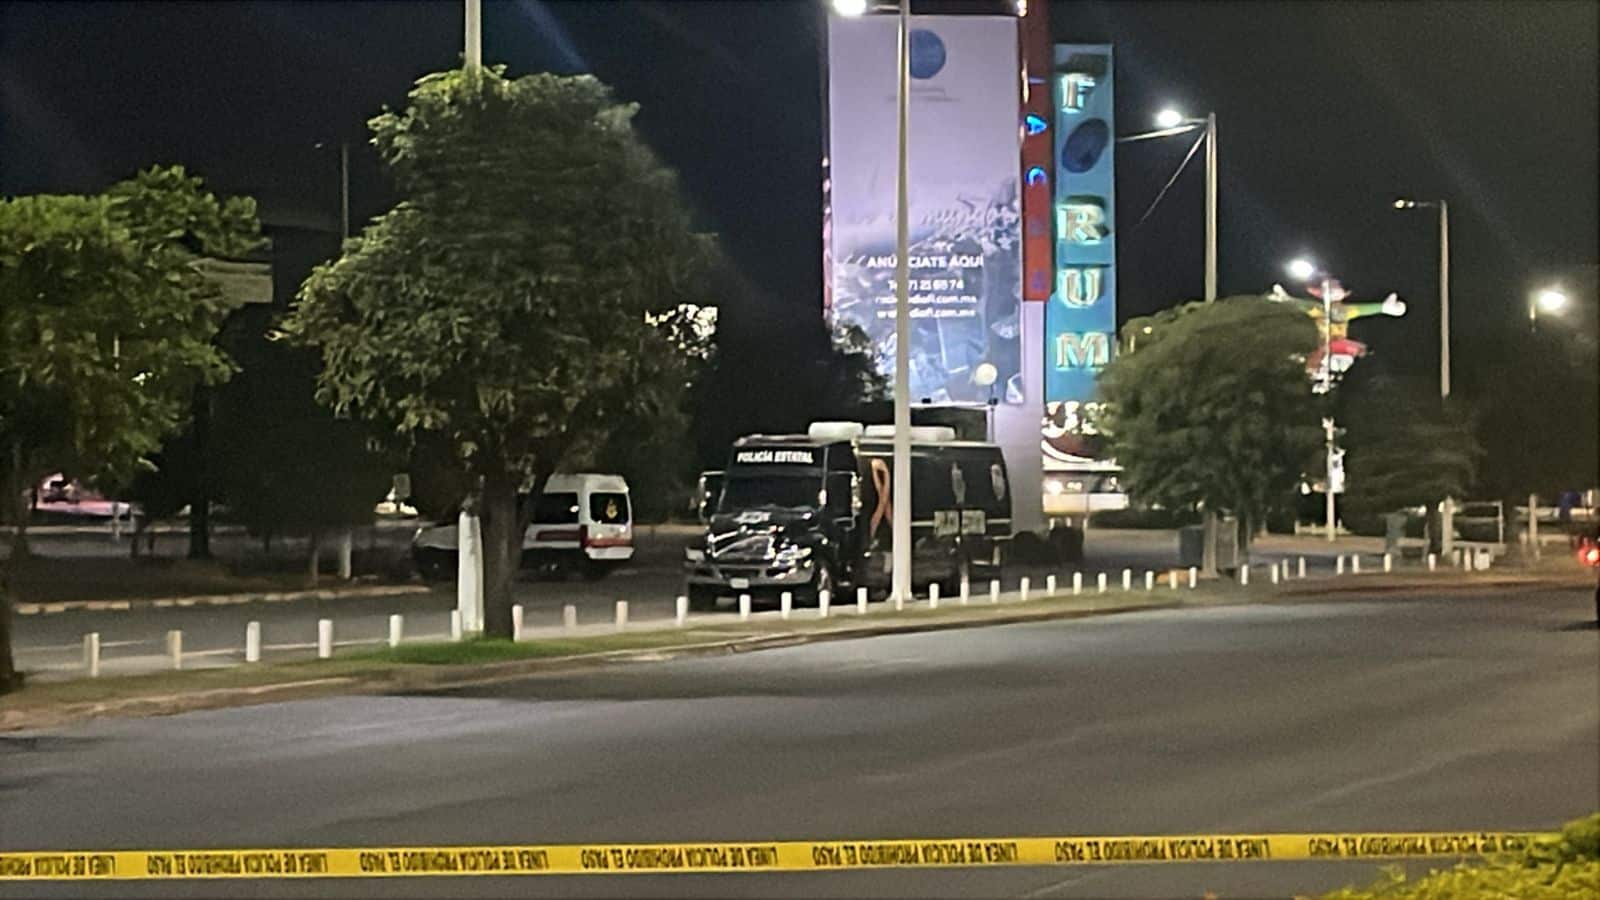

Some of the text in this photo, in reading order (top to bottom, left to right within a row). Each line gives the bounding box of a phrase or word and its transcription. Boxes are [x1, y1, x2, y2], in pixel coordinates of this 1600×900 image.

[867, 254, 947, 269] ANÚCIATE
[774, 451, 814, 464] ESTATAL
[580, 849, 609, 869] PASO
[610, 849, 624, 868] EL
[626, 848, 683, 868] PROHIBIDO
[685, 847, 728, 867] POLICIA
[729, 847, 744, 867] DE
[812, 845, 842, 865] PASO
[843, 844, 857, 865] EL
[860, 844, 918, 864] PROHIBIDO
[920, 843, 965, 863] POLICIA
[966, 843, 983, 863] DE
[1055, 840, 1084, 861] PASO
[1086, 840, 1100, 861] EL
[1103, 839, 1166, 860] PROHIBIDO
[1168, 839, 1214, 859] POLICIA
[1216, 839, 1234, 859] DE
[34, 855, 71, 875] POLICIA
[73, 855, 87, 874] DE
[147, 854, 172, 873] PASO
[174, 854, 186, 873] EL
[187, 853, 241, 873] PROHIBIDO
[242, 853, 281, 872] POLICIA
[282, 852, 297, 872] DE
[359, 851, 385, 871] PASO
[388, 851, 401, 871] EL
[402, 850, 457, 871] PROHIBIDO
[459, 850, 501, 870] POLICIA
[502, 850, 515, 870] DE
